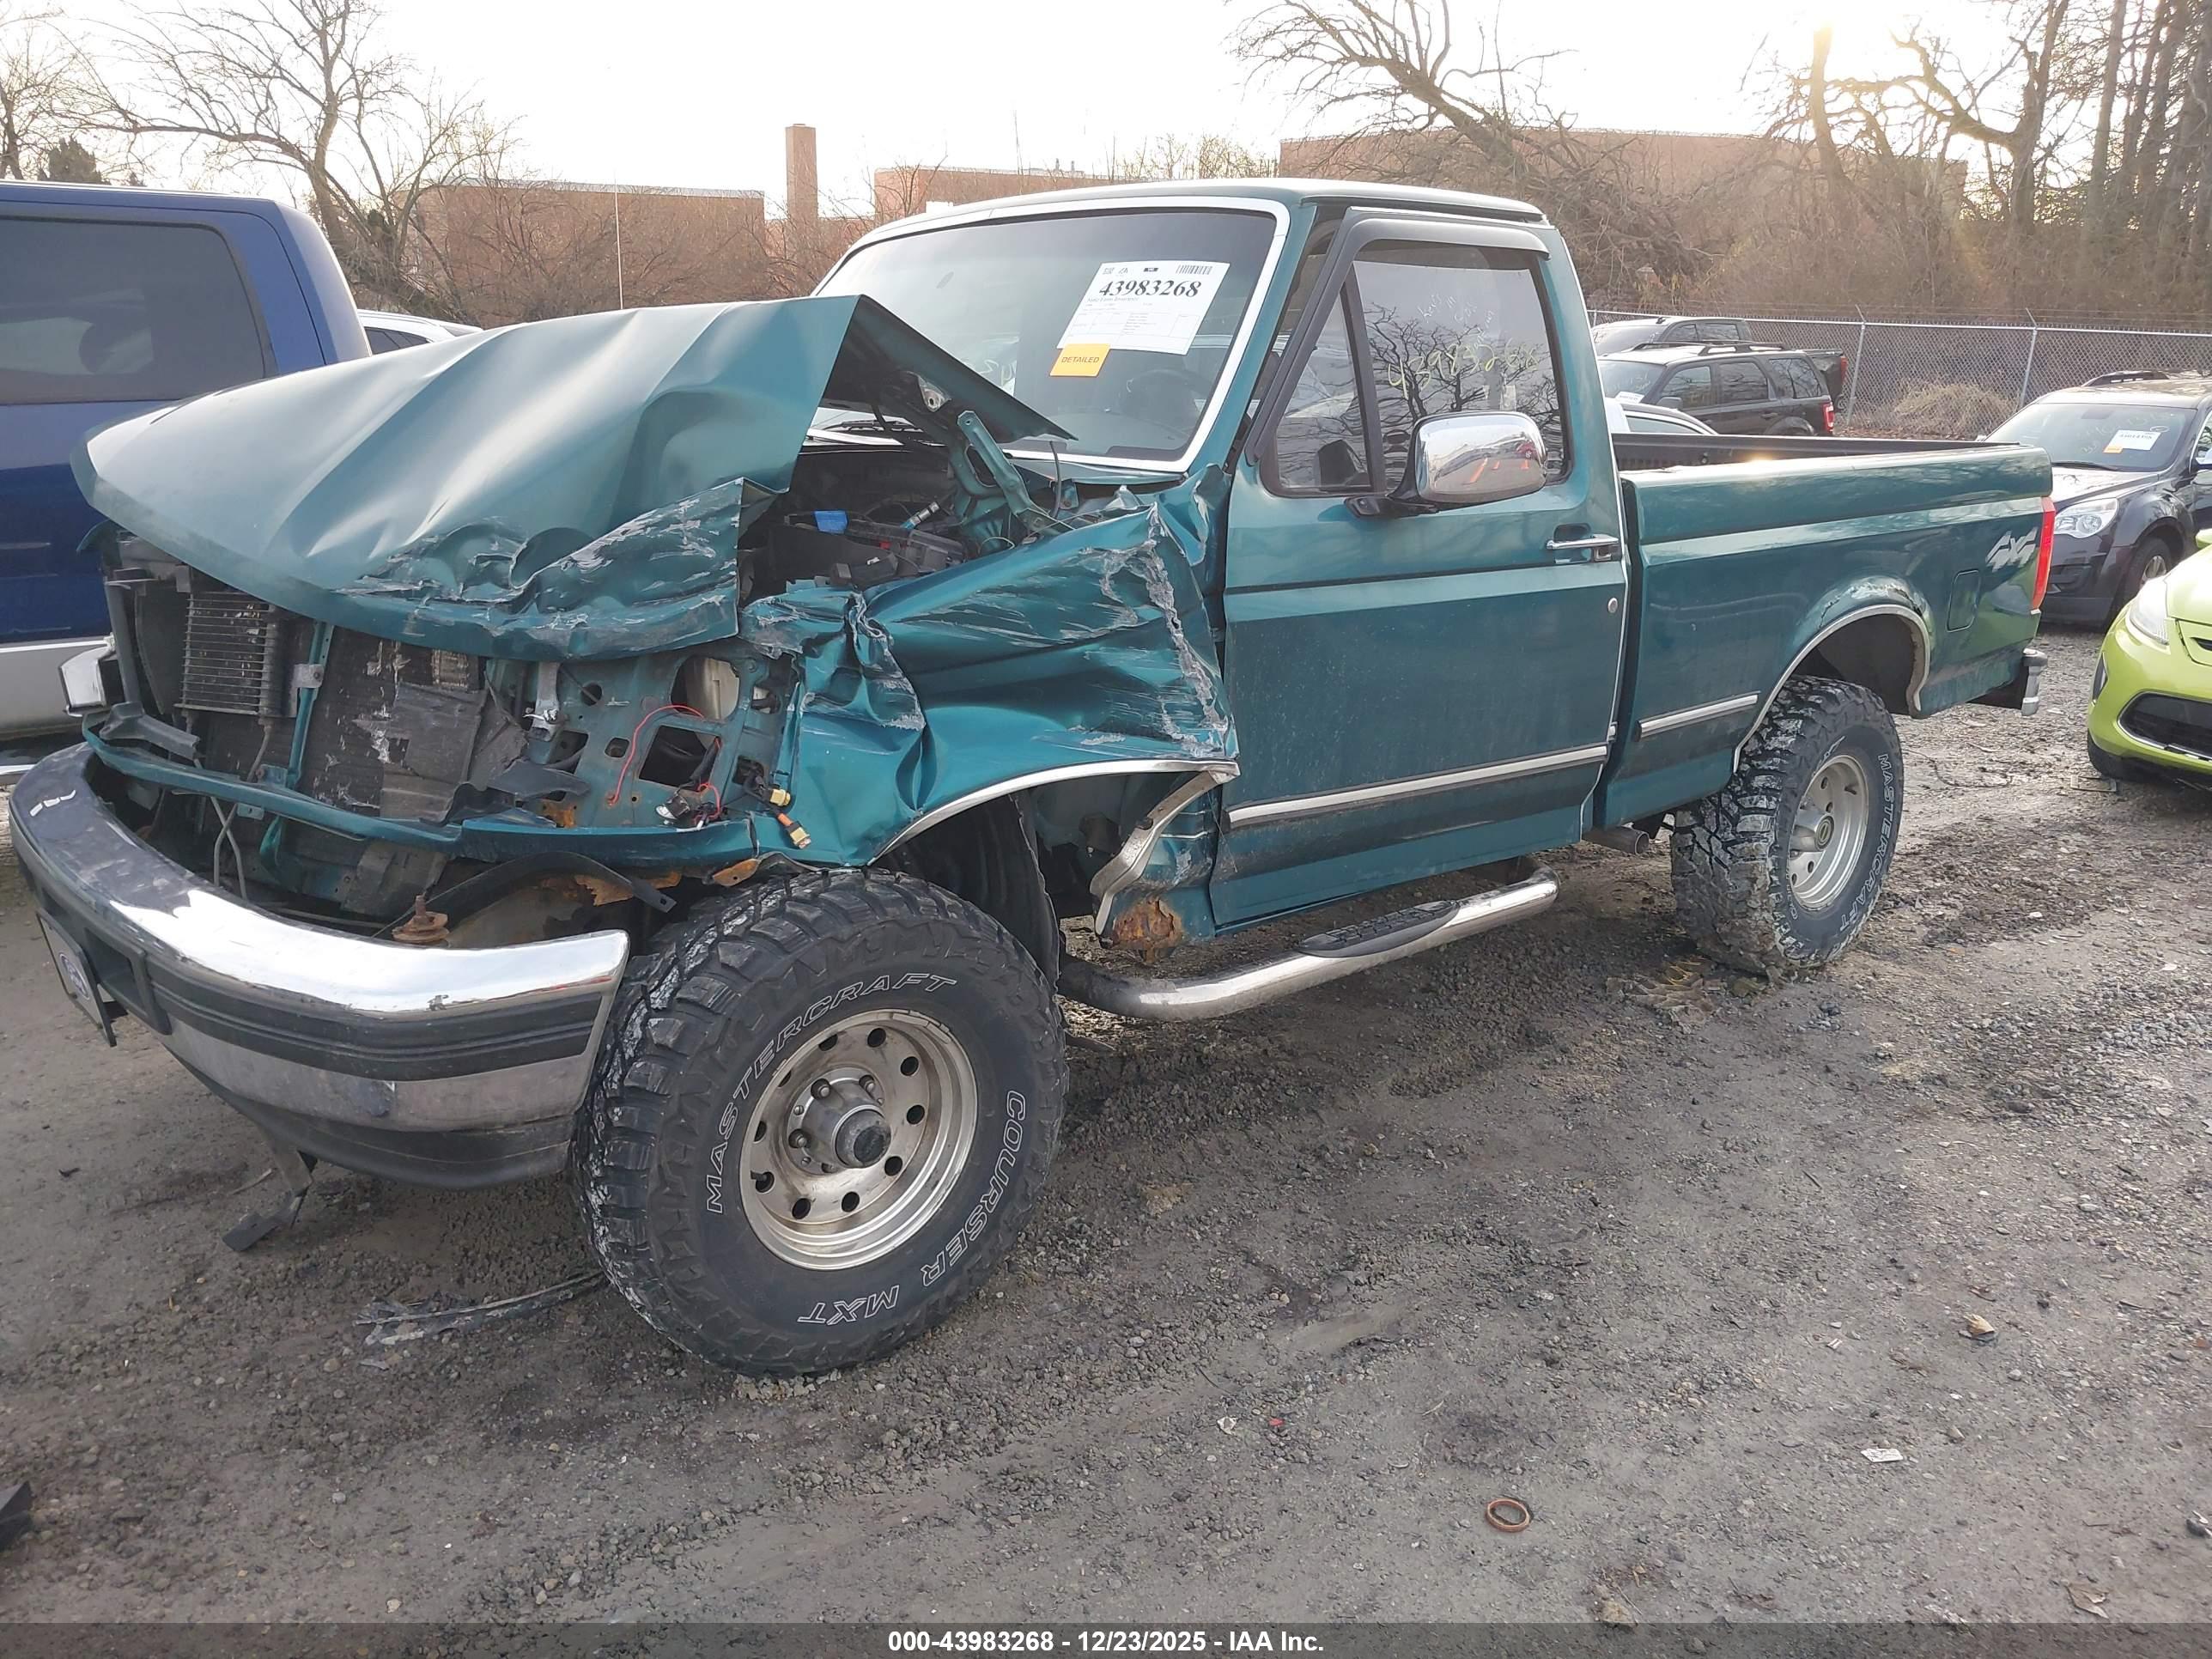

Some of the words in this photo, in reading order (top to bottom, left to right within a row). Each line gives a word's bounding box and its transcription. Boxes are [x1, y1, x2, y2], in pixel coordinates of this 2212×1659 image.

[1099, 280, 1202, 298] 43983268
[1839, 753, 1895, 932] MASTERCRAFT
[706, 973, 958, 1213] MASTERCRAFT
[921, 1090, 1026, 1287] COURSER
[798, 1285, 900, 1327] MXT
